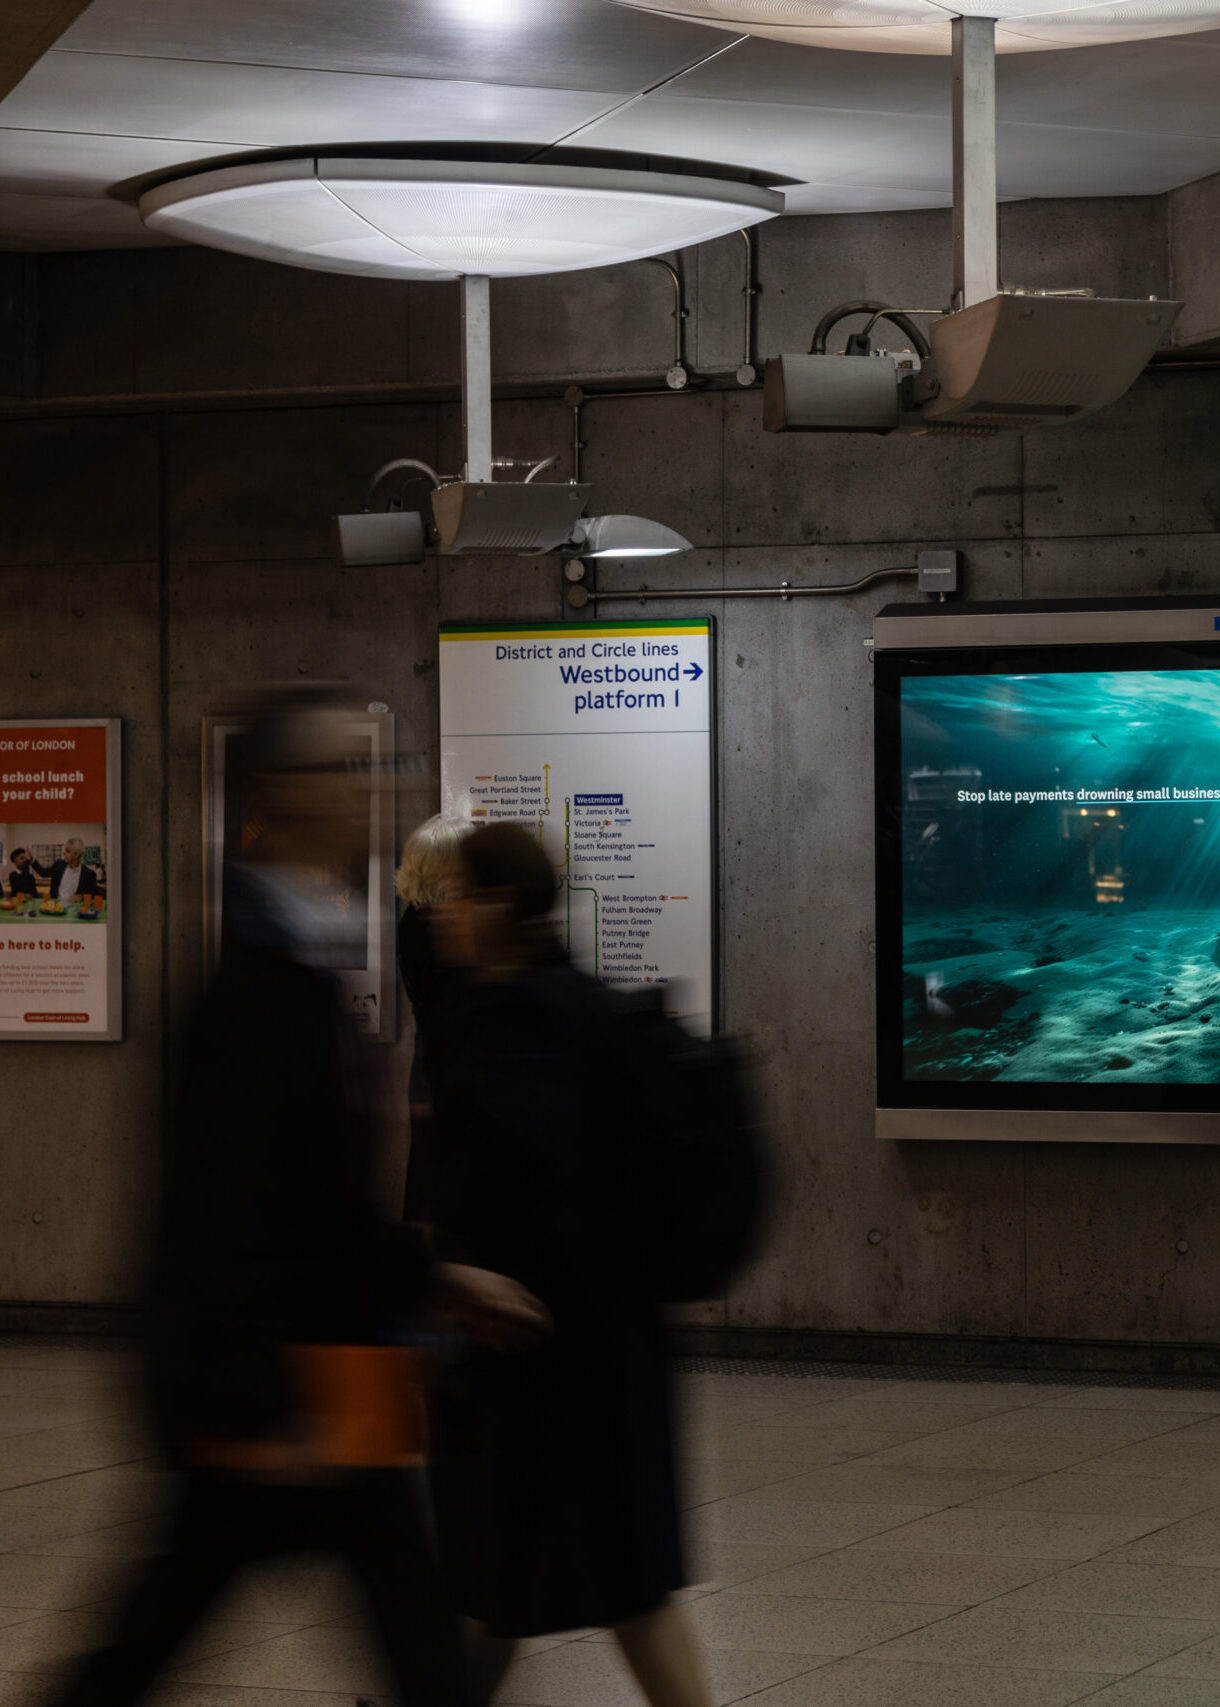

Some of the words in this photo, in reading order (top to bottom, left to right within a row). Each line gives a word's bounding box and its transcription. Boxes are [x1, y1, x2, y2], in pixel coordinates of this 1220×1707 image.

[496, 645, 552, 660] District
[558, 644, 585, 659] and
[592, 643, 636, 657] Circle
[643, 642, 678, 656] lines
[560, 663, 679, 684] Westbound
[575, 690, 664, 714] platform
[675, 689, 678, 707] 1
[16, 740, 29, 750] OF
[32, 740, 75, 750] LONDON
[2, 770, 45, 783] school
[48, 770, 84, 783] lunch
[519, 775, 541, 783] Square
[2, 790, 32, 803] your
[34, 788, 74, 800] child?
[576, 796, 622, 804] Westminster
[957, 790, 986, 804] Stop
[988, 790, 1011, 802] late
[1014, 790, 1074, 804] payments
[1076, 788, 1134, 802] drowning
[1136, 788, 1170, 800] small
[490, 809, 517, 818] Edgware
[598, 832, 622, 840] Square
[597, 842, 635, 852] Kensington
[574, 854, 611, 862] Gloucester
[623, 895, 657, 903] Brompton
[629, 906, 662, 914] Broadway
[602, 930, 626, 938] Putney
[629, 930, 649, 938] Bridge
[8, 940, 35, 950] here
[38, 940, 51, 950] to
[55, 939, 85, 952] help.
[620, 941, 643, 950] Putney
[602, 964, 642, 972] Wimbledon
[602, 976, 642, 984] Wimbledon
